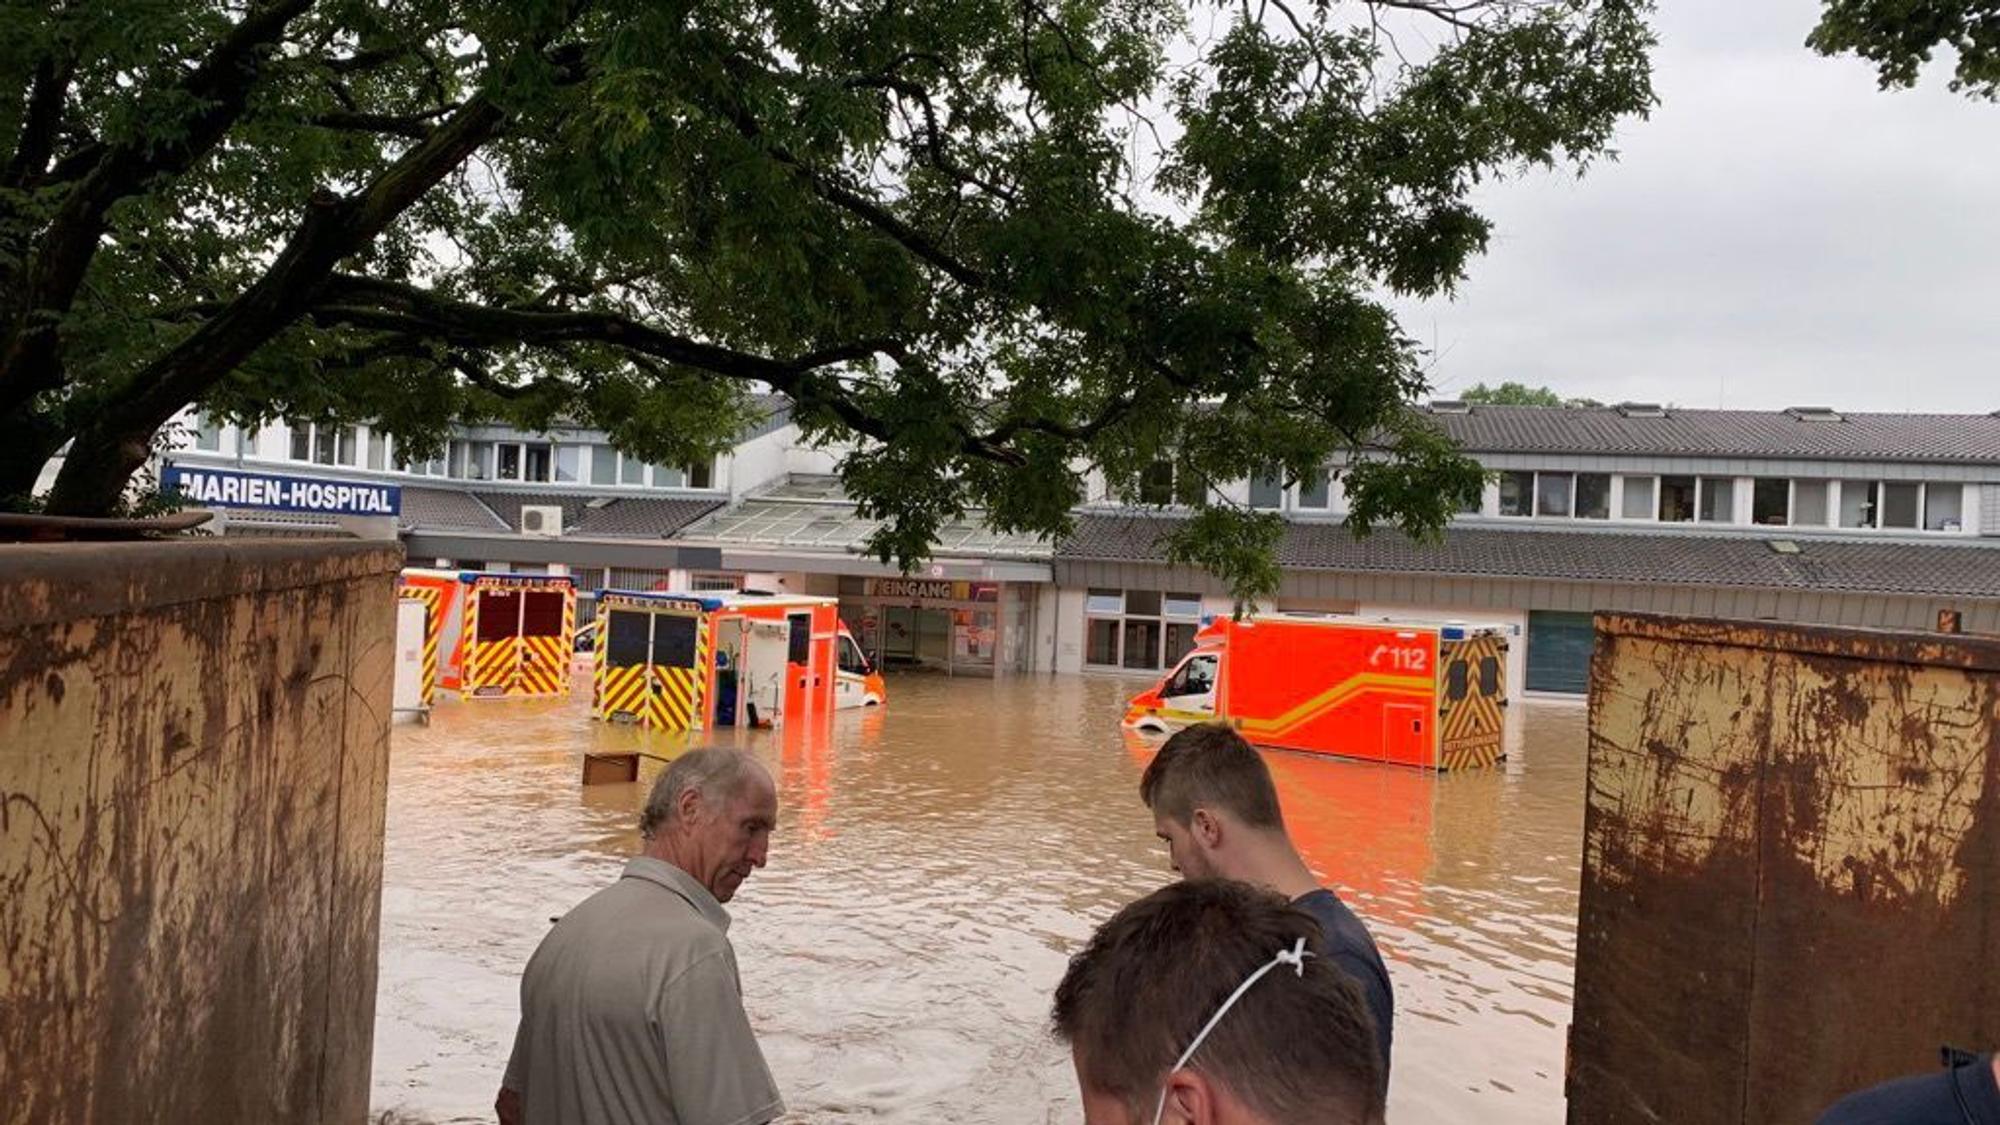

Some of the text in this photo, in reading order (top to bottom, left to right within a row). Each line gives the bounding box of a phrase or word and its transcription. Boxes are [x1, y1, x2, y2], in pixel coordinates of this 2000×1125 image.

[180, 473, 392, 513] MARIEN-HOSPITAL
[881, 580, 951, 599] EINGANG
[1389, 646, 1427, 670] 112
